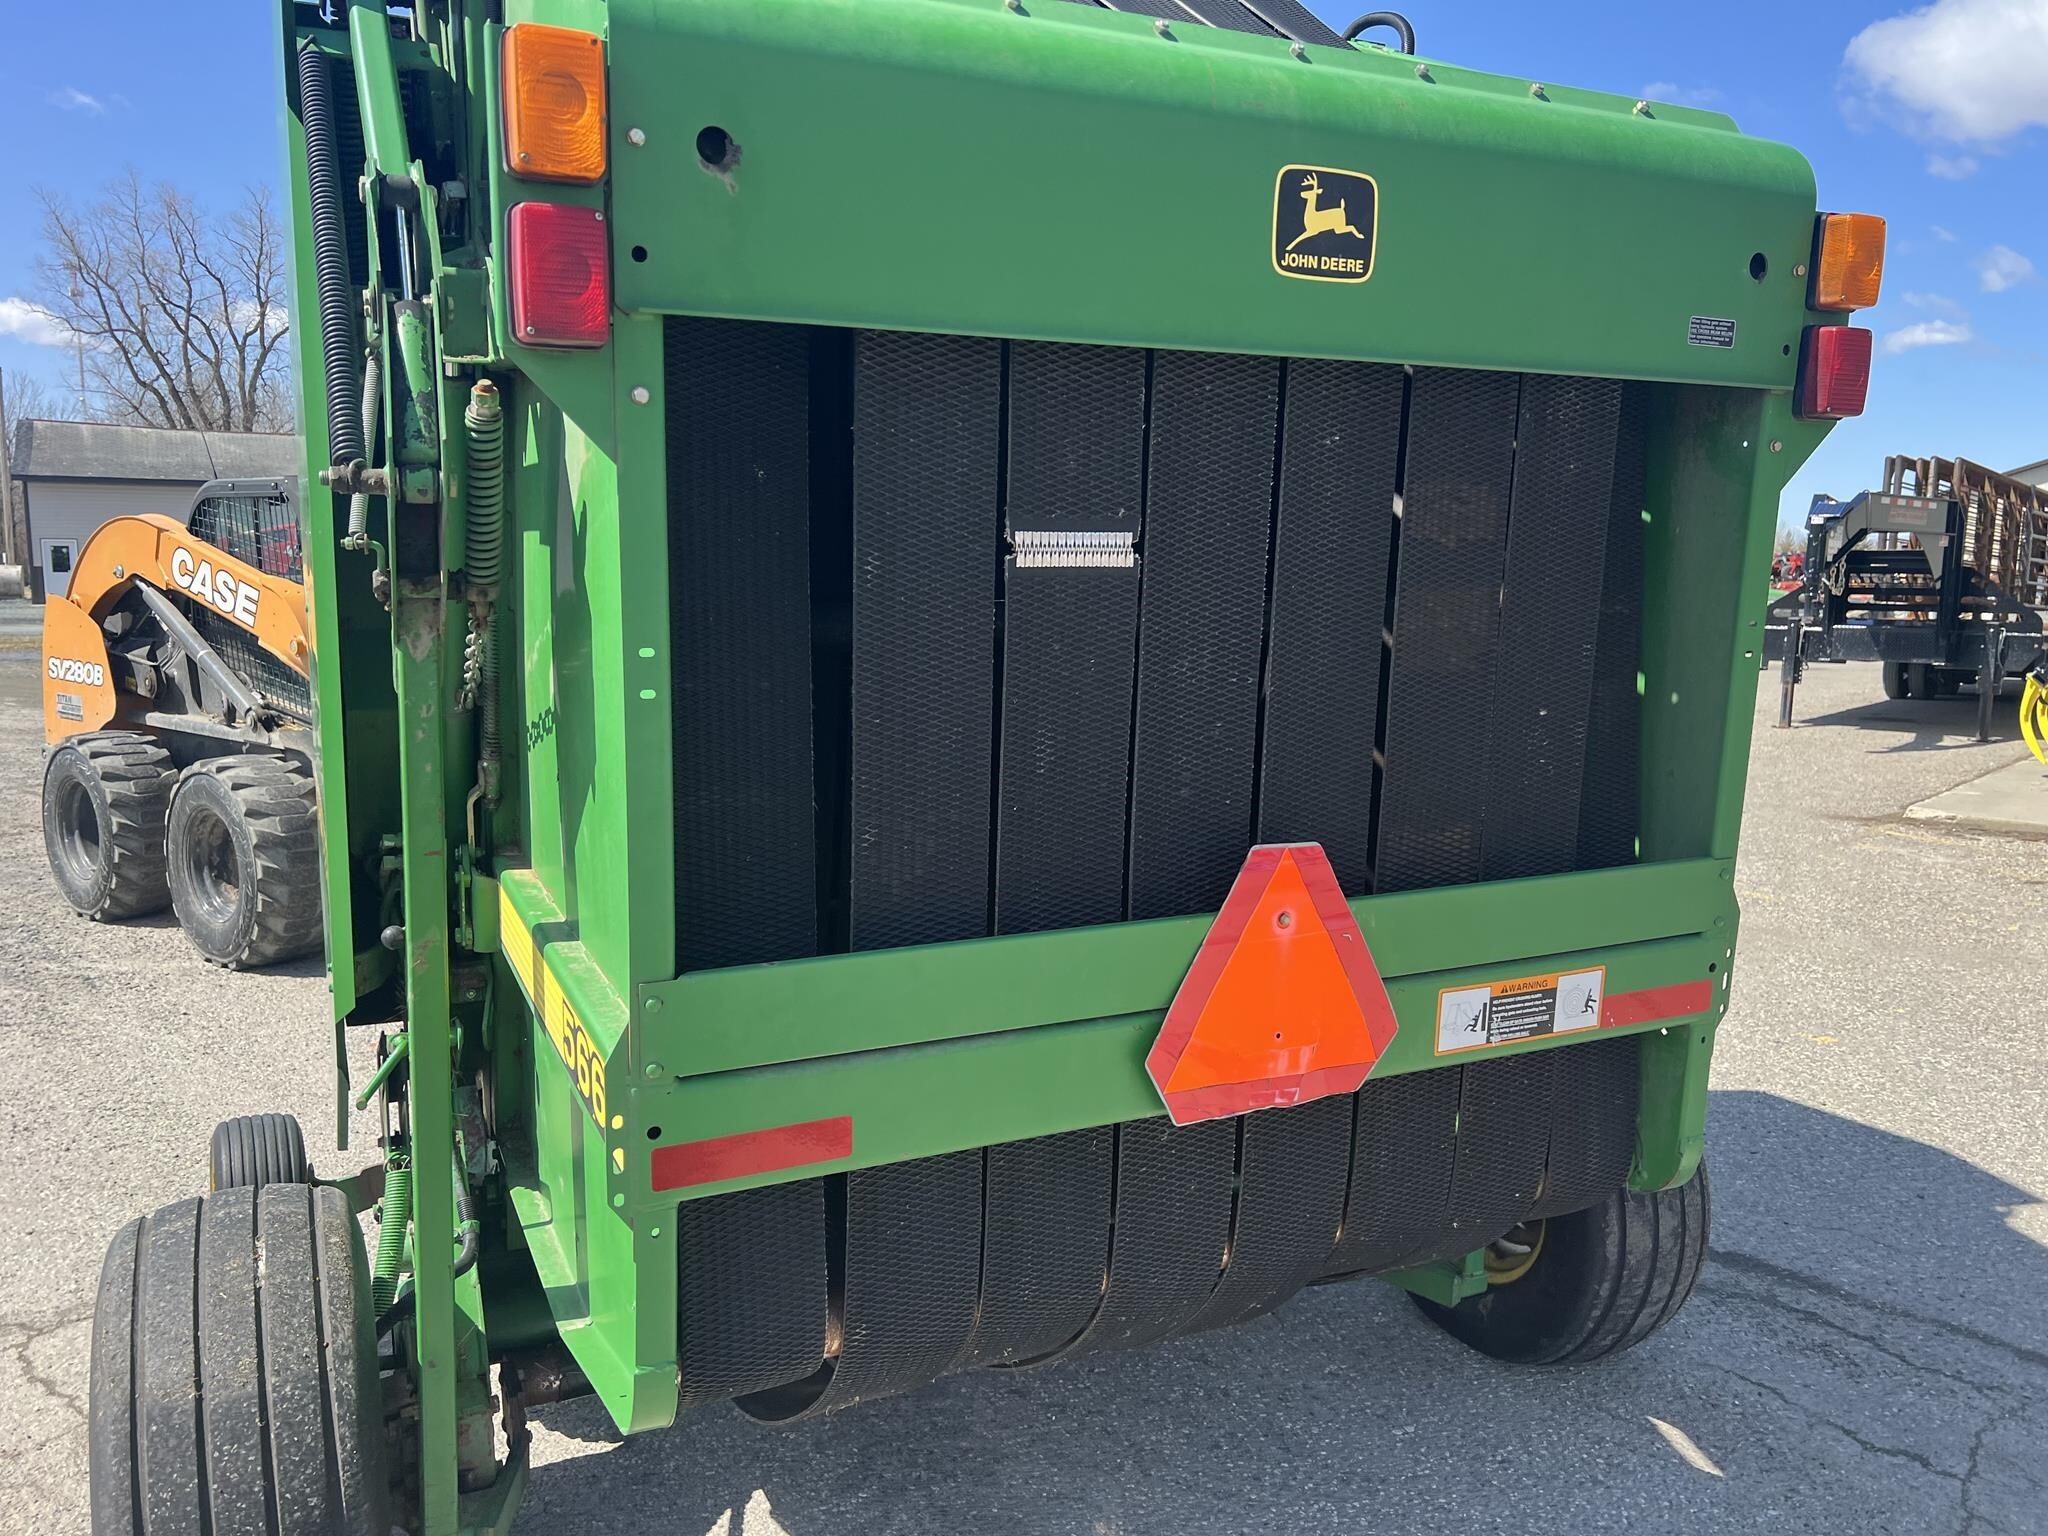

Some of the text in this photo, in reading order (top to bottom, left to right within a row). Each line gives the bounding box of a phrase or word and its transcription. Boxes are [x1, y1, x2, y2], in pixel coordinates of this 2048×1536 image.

[1281, 252, 1364, 273] JOHN DEERE
[171, 546, 260, 628] CASE
[48, 656, 104, 687] SV280B
[1508, 979, 1549, 993] WARNING
[562, 999, 606, 1129] 566
